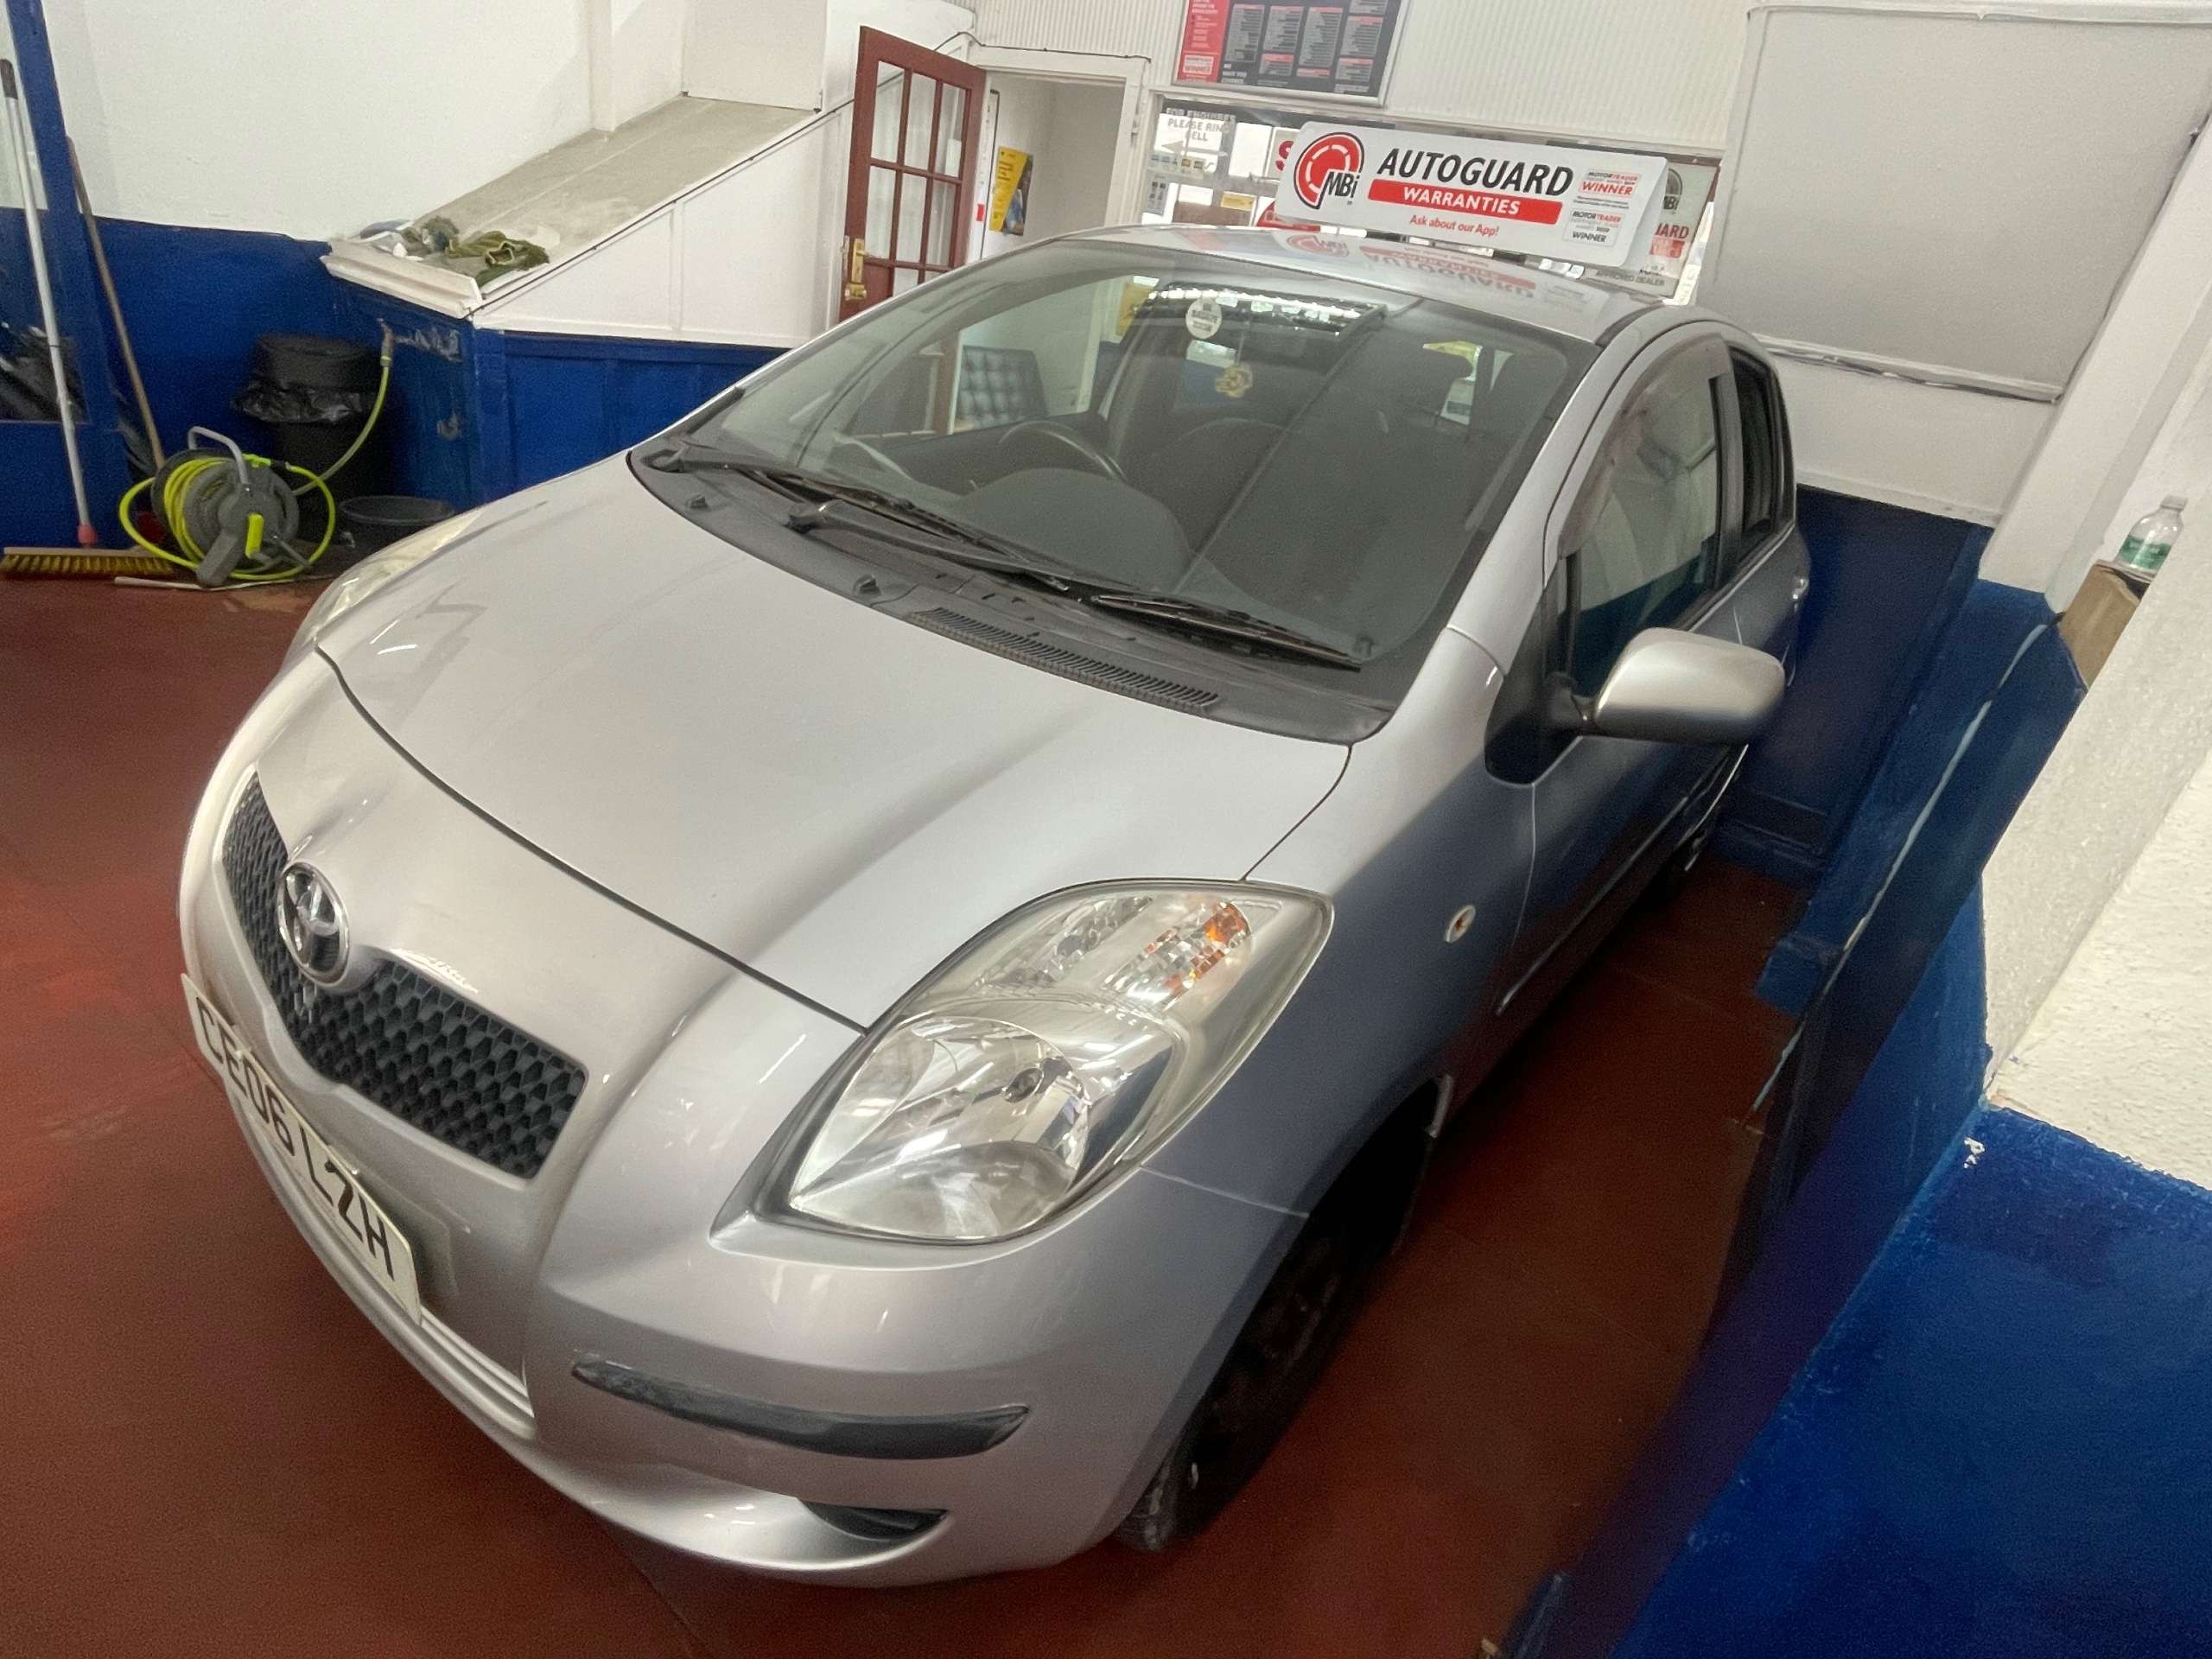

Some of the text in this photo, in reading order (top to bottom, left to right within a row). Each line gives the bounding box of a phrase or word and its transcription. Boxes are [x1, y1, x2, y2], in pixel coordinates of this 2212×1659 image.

[1167, 118, 1204, 131] PLEASE
[1324, 170, 1360, 199] MBi
[1376, 148, 1573, 196] AUTOGUARD
[1403, 186, 1522, 215] WARRANTIES
[1582, 181, 1633, 195] WINNER
[1409, 214, 1500, 238] Ask about our App!
[1572, 232, 1607, 242] WINNER
[196, 995, 395, 1281] CE06 LZH
